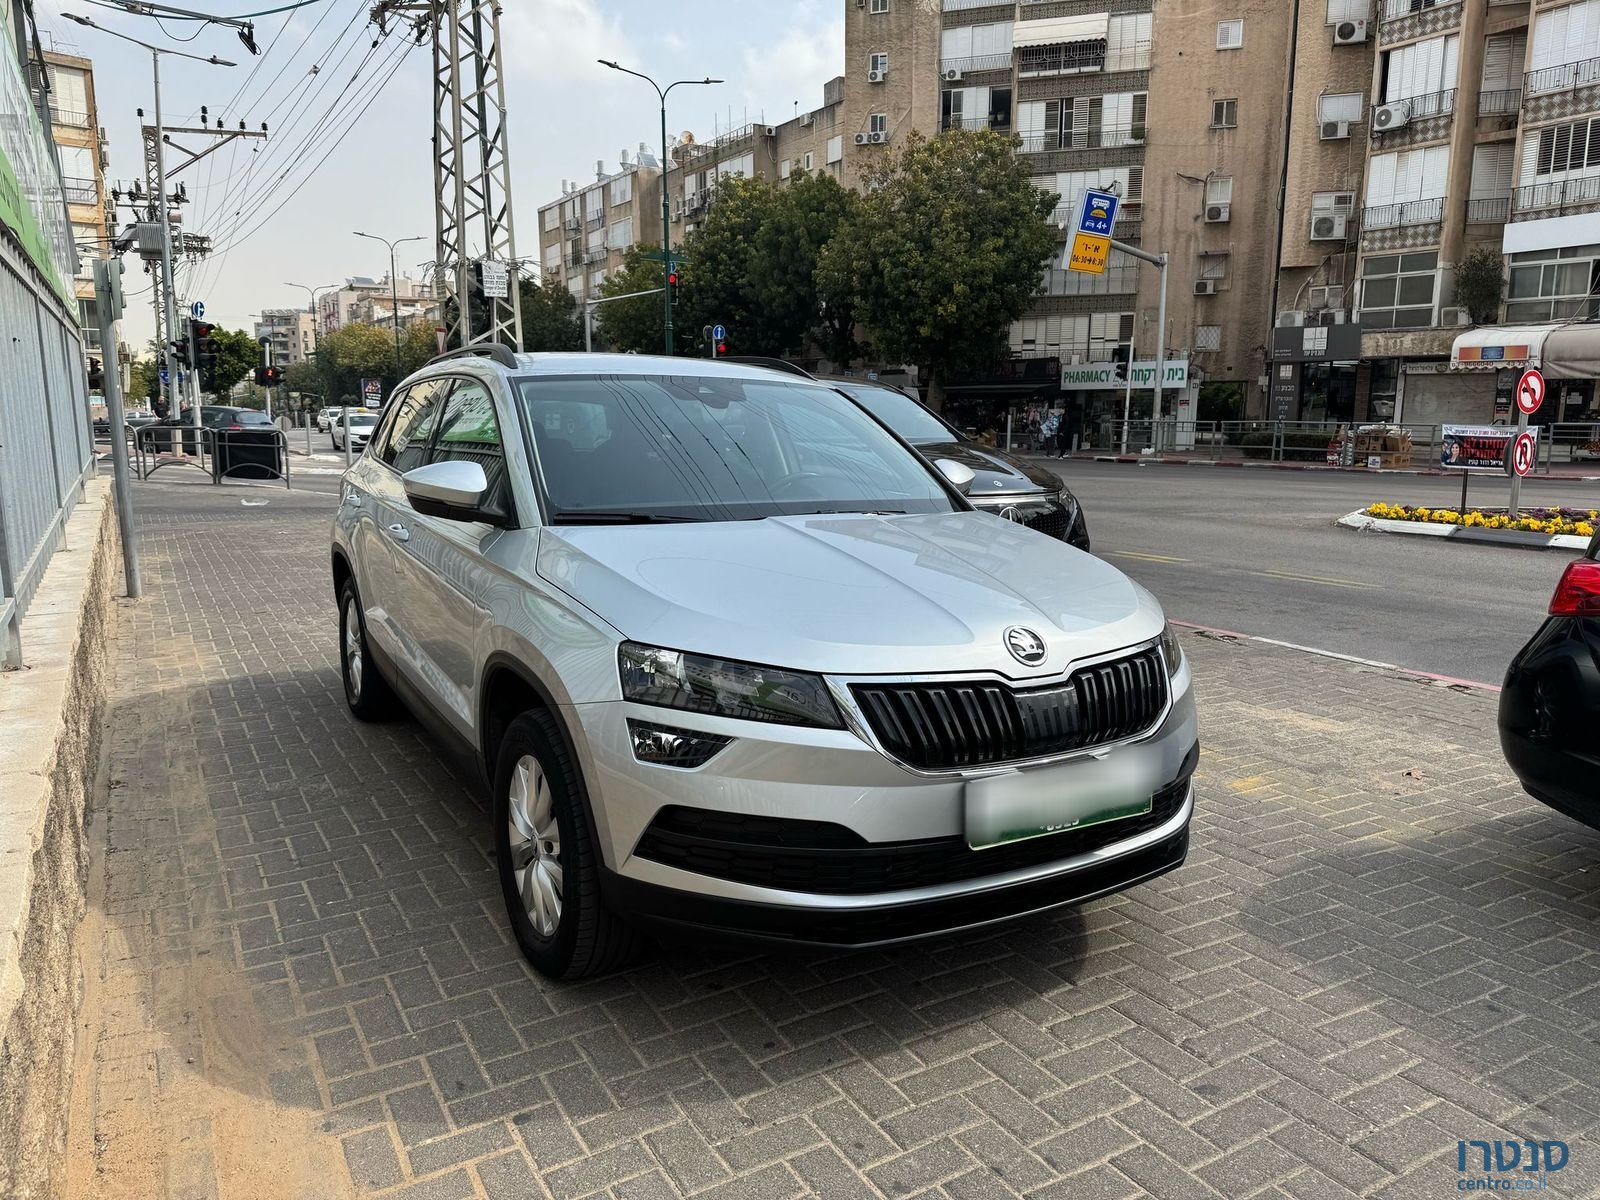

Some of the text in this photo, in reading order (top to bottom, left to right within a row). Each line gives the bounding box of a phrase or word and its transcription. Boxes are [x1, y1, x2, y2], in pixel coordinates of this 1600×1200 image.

[1096, 221, 1107, 230] 4+
[1063, 370, 1111, 383] PHARMACY
[1130, 367, 1185, 385] בית רקחת
